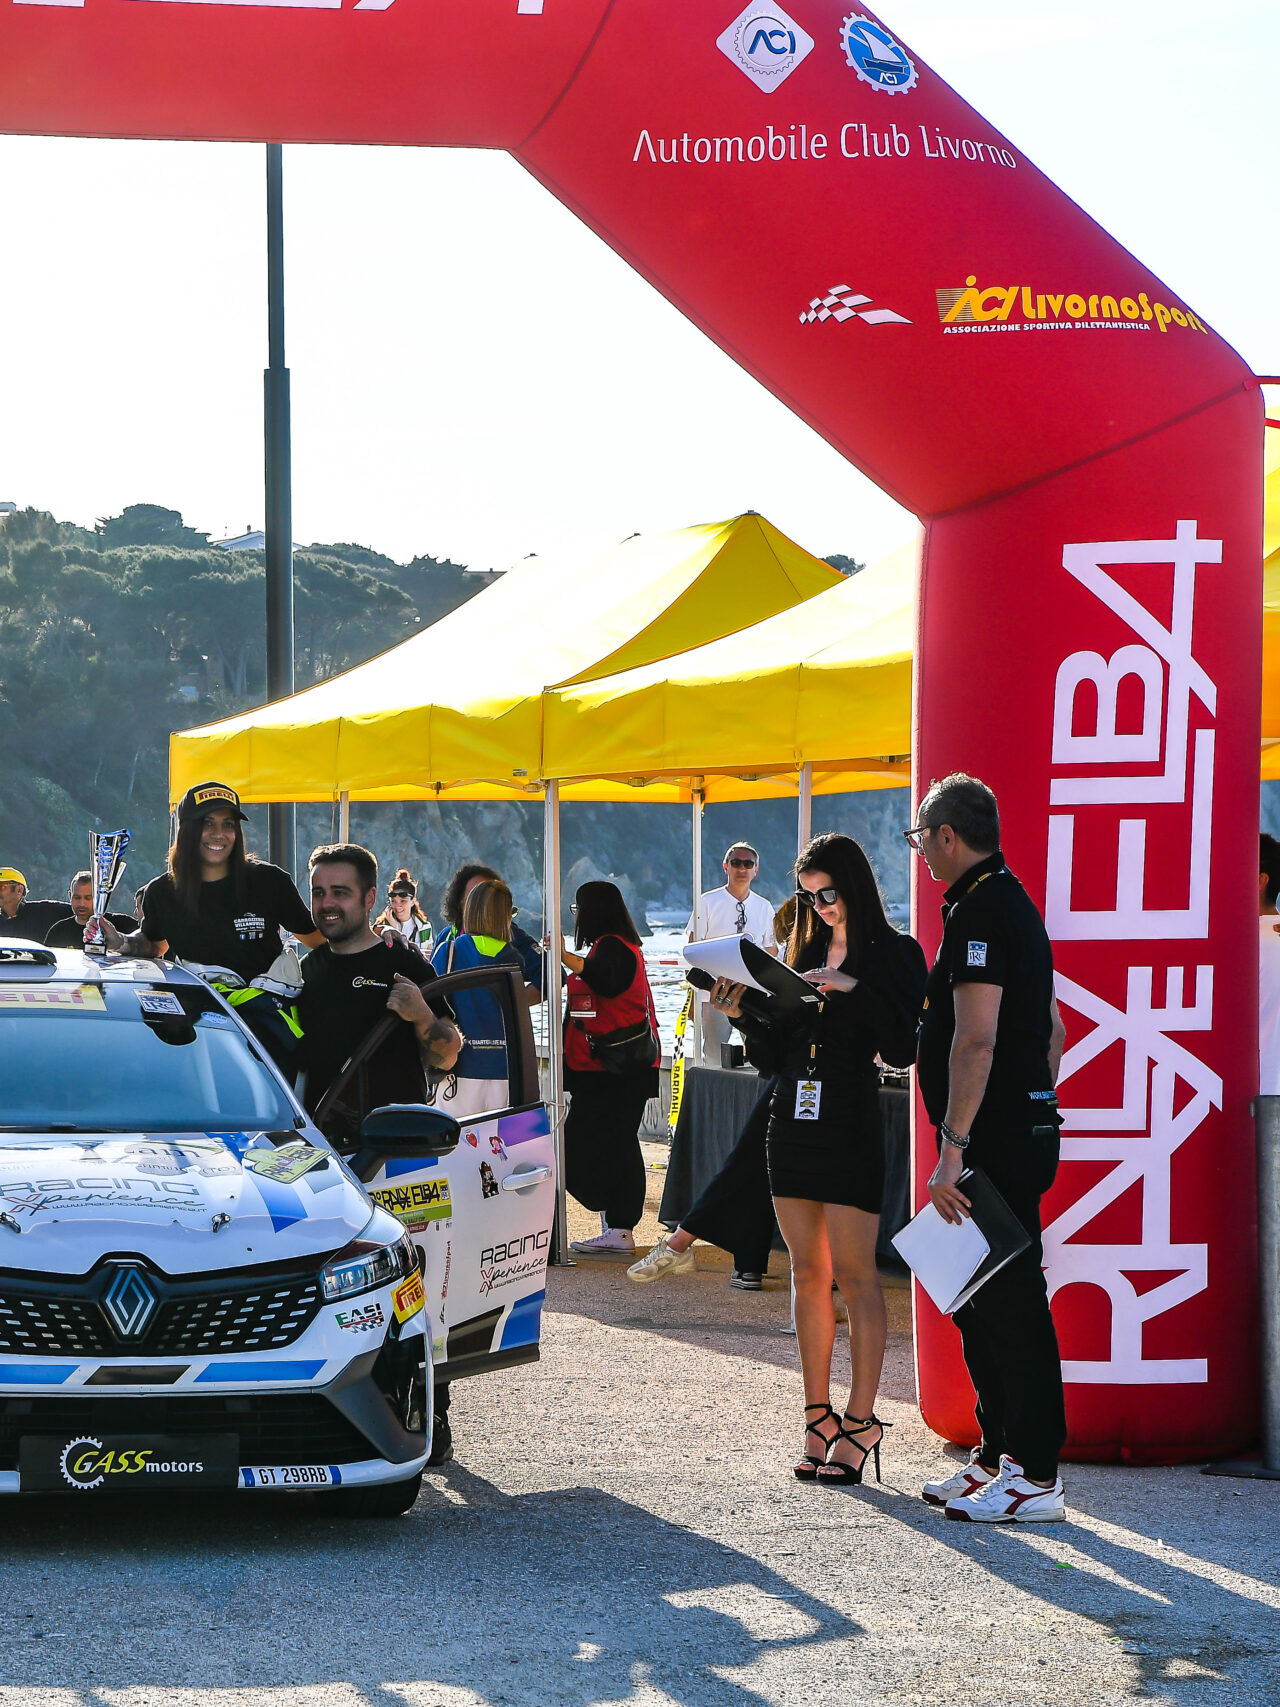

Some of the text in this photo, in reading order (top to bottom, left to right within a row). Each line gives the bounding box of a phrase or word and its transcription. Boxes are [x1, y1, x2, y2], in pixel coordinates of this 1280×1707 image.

[748, 29, 796, 55] ACI
[878, 72, 898, 85] ACI
[632, 122, 1018, 170] Automobile Club Livorno
[943, 320, 1151, 335] ASSOCIAZIONE SPORTIVA DILETTANTISTICA
[1045, 519, 1223, 941] ELBA
[671, 1065, 681, 1114] BARDAHL
[73, 1450, 204, 1474] GASS motors
[259, 1467, 328, 1485] GT 298RB
